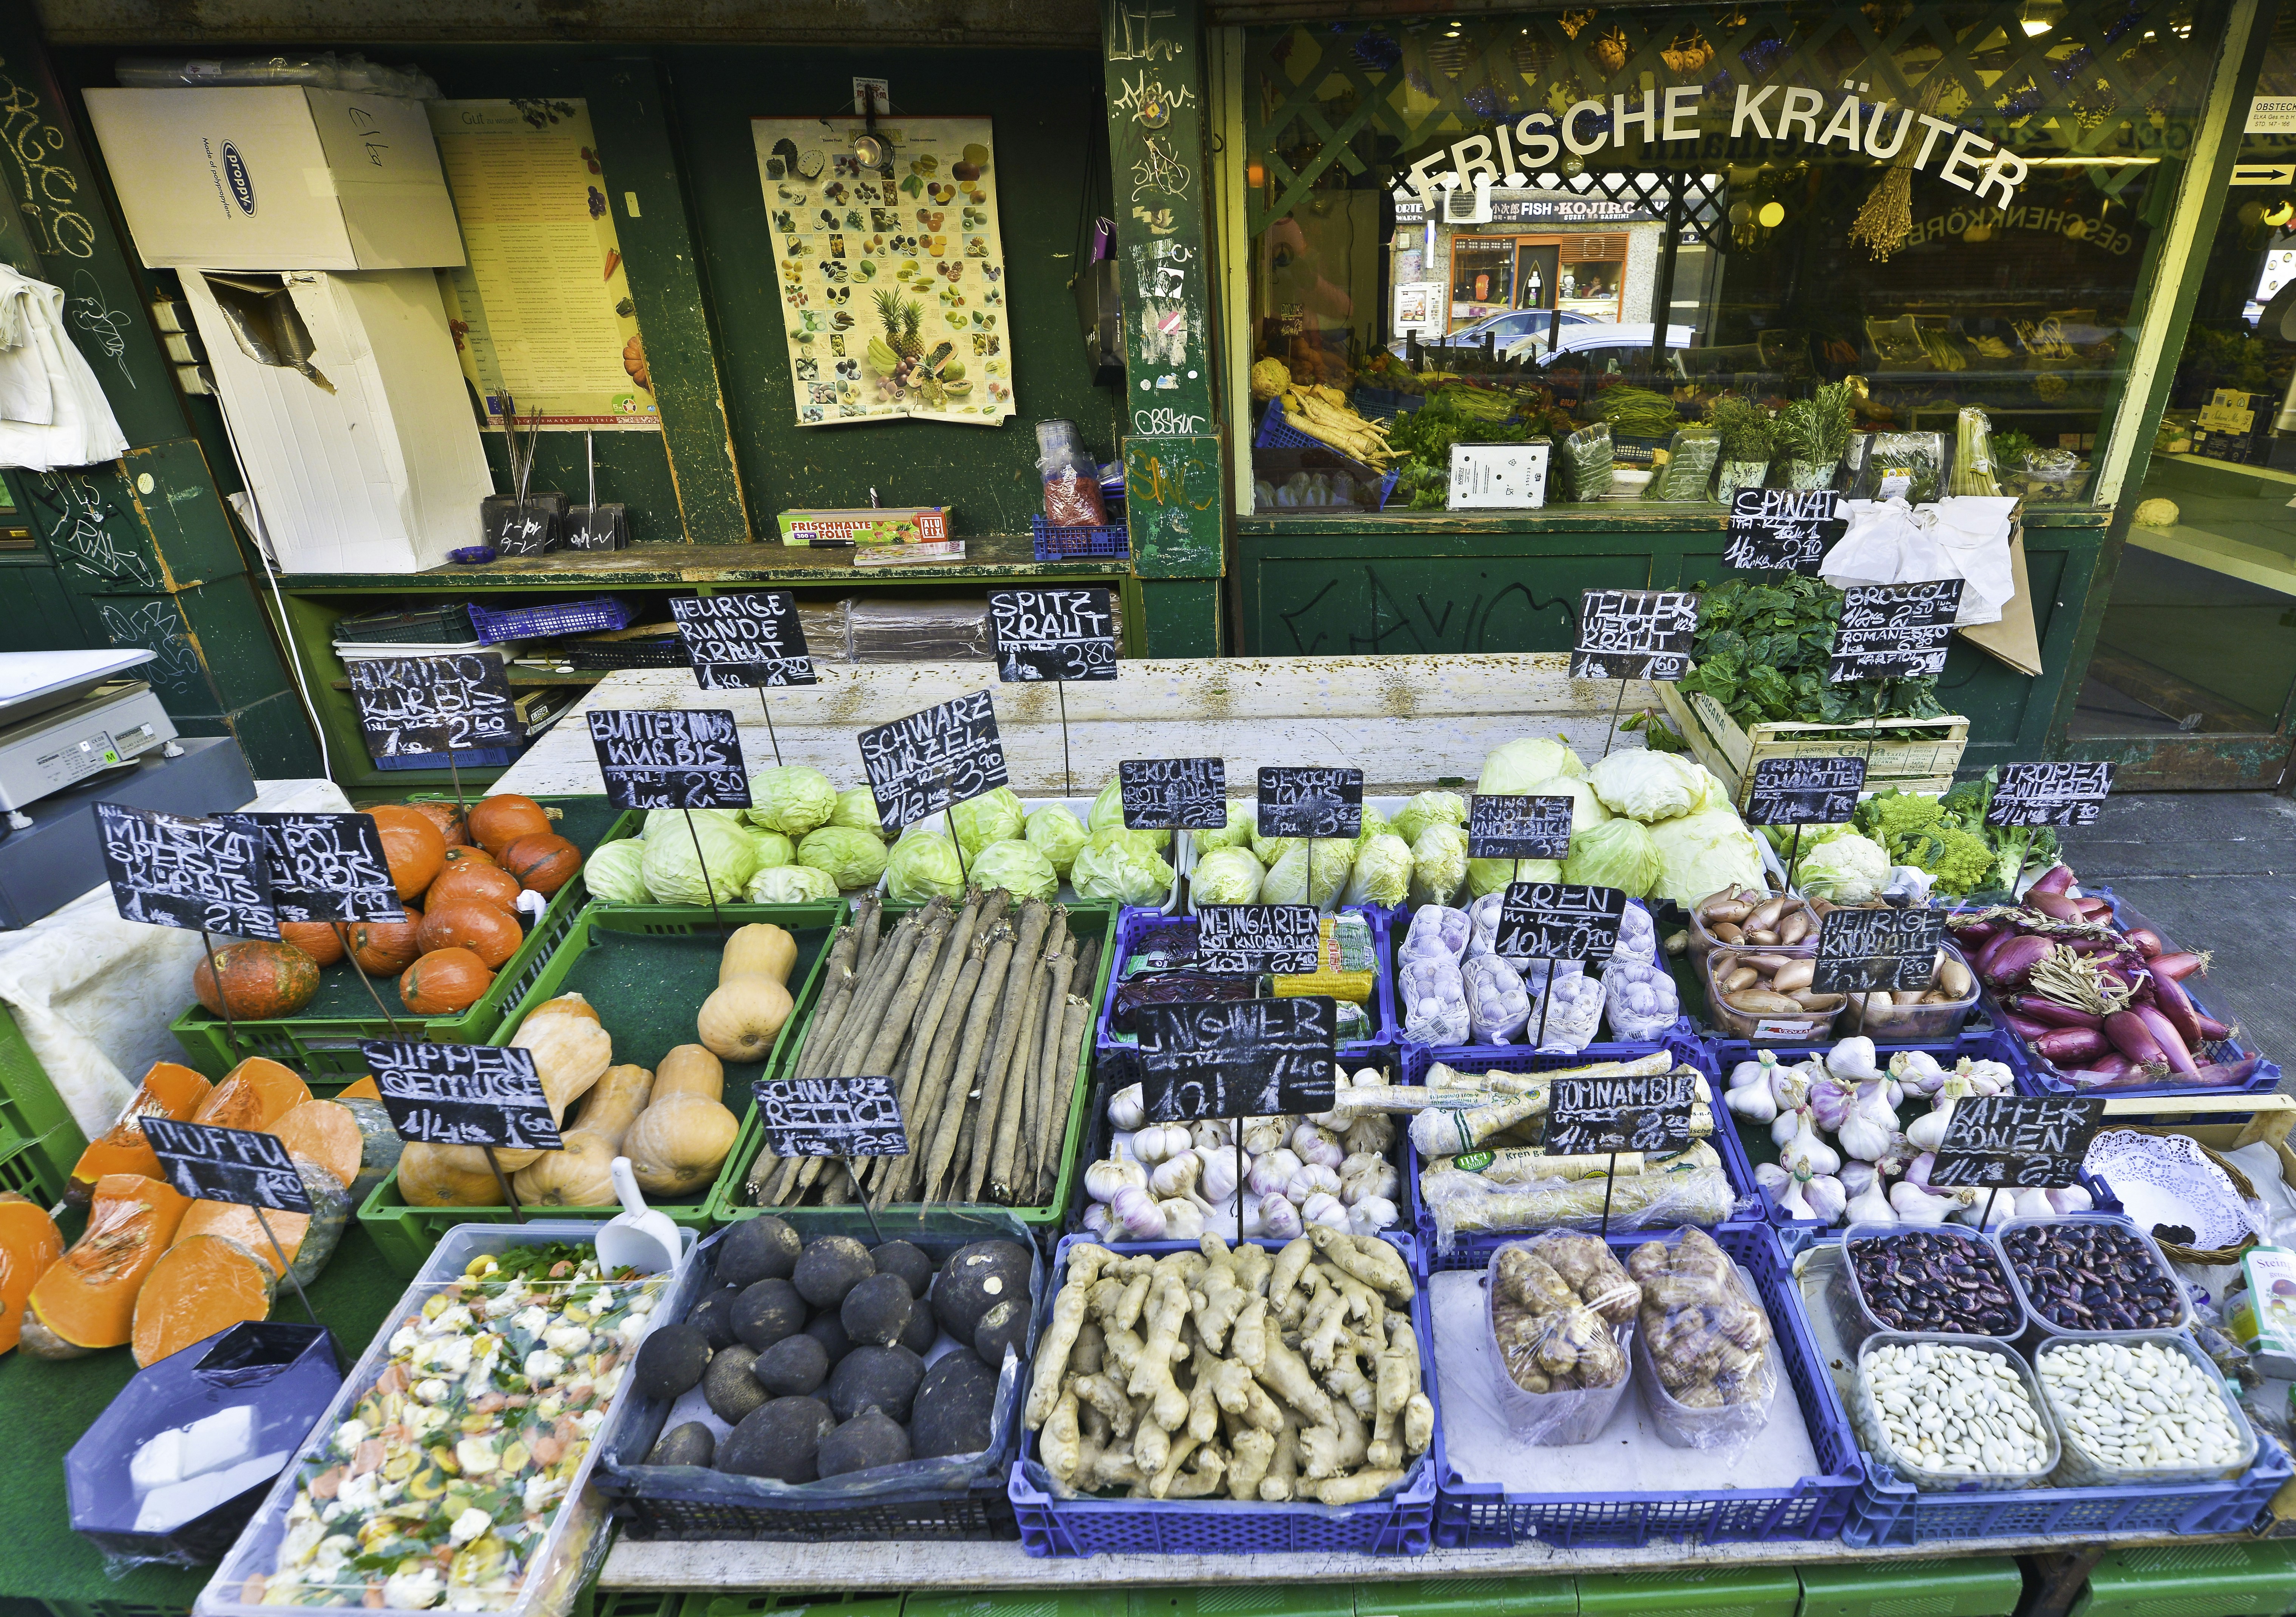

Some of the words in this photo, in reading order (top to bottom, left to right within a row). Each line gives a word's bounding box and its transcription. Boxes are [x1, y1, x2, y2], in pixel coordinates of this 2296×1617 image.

[462, 111, 485, 125] Gut
[202, 137, 213, 160] Made
[210, 160, 217, 170] of
[1410, 85, 1703, 212] FRISCHE
[1731, 80, 2028, 211] KRÄUTER
[227, 155, 252, 206] proppy
[1395, 203, 1423, 214] ORTE
[1521, 203, 1552, 215] FISH
[1735, 489, 1840, 518] SPINAT
[791, 521, 871, 531] FRISCHHALTE
[819, 529, 853, 539] FOLIE
[924, 519, 940, 528] ALU
[924, 528, 941, 537] FIX
[990, 592, 1095, 617] SPITZ
[1583, 590, 1698, 621] TELLER
[1846, 580, 1958, 608] BROCCOLI
[671, 595, 786, 620] HEURIGE
[679, 619, 778, 642] RUNDE
[997, 612, 1109, 640] KRAUT
[1582, 616, 1657, 635] WEICH
[1841, 626, 1948, 643] ROMANESKO
[687, 641, 784, 663] KRAUT
[1581, 630, 1676, 651] KRAUT
[861, 693, 992, 761] SCHWARZ
[106, 753, 115, 762] M
[867, 726, 980, 785] WURZEL
[2006, 762, 2109, 785] TROPEA
[1276, 785, 1344, 805] MAIS
[261, 827, 373, 863] APOLI
[268, 852, 389, 890] ÜRBIS
[1510, 883, 1609, 912] KREN
[1197, 907, 1320, 934] WEINGARTEN
[361, 1041, 532, 1078] SUPPEN
[1506, 1150, 1530, 1161] Kren
